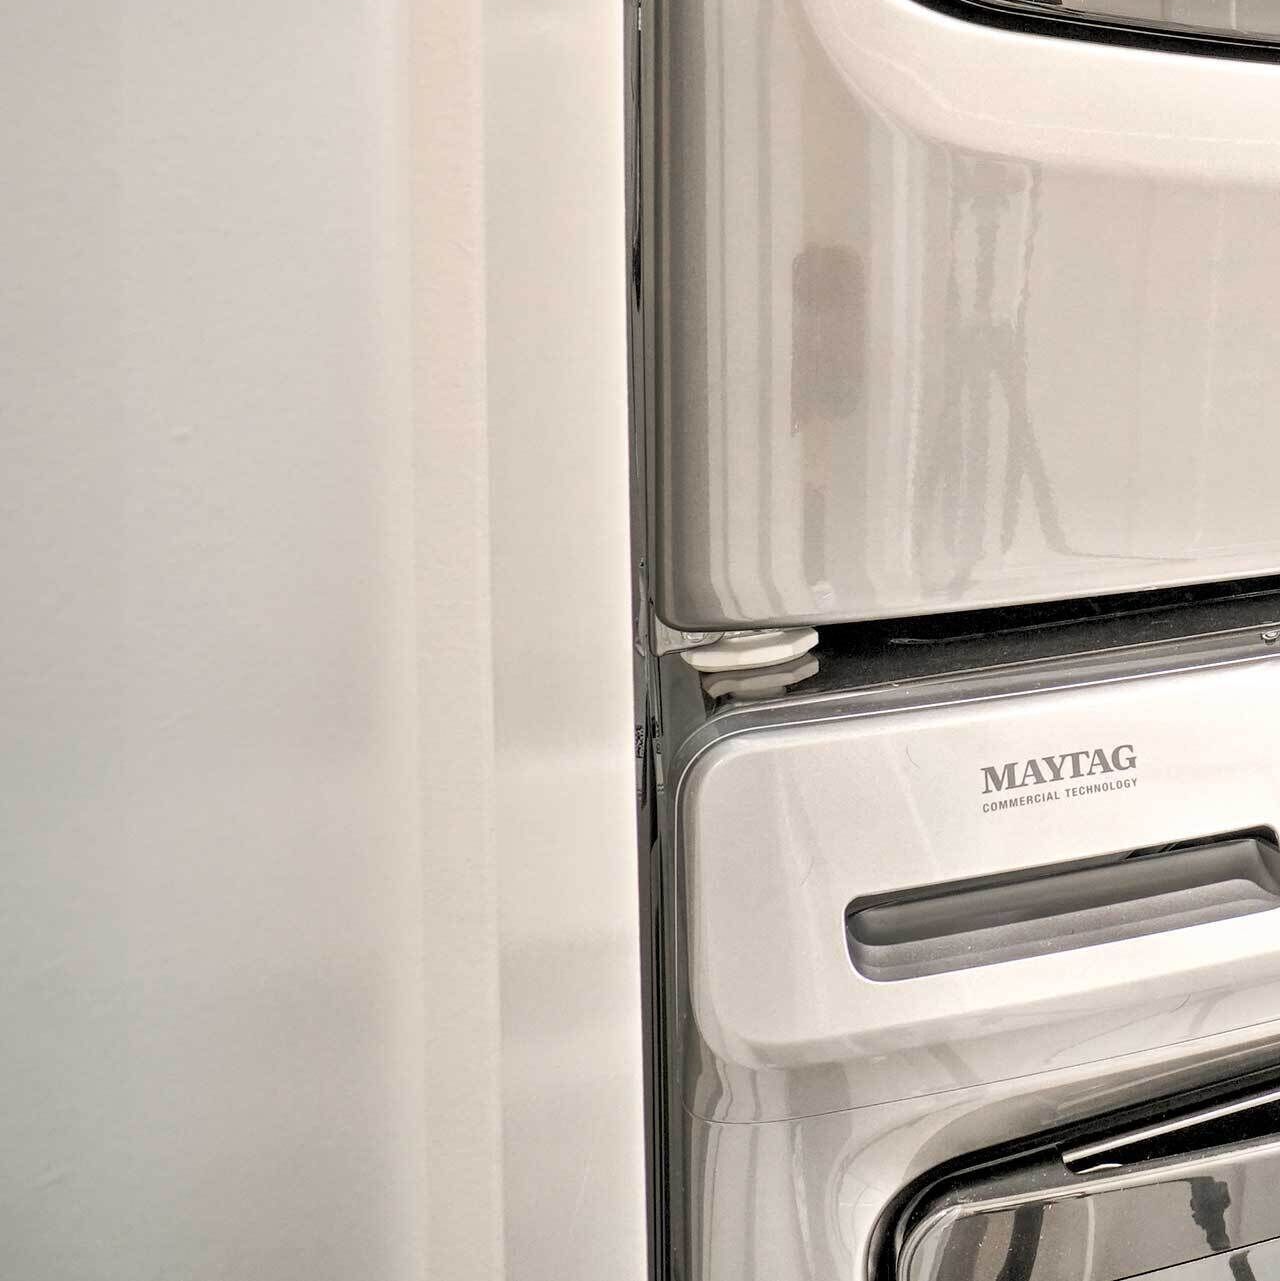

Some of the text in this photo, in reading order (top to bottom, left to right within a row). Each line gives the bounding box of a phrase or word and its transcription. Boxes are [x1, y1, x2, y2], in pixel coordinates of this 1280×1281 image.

[980, 744, 1137, 794] MAYTAG
[982, 777, 1138, 813] COMMERCIAL TECHNOLOGY
